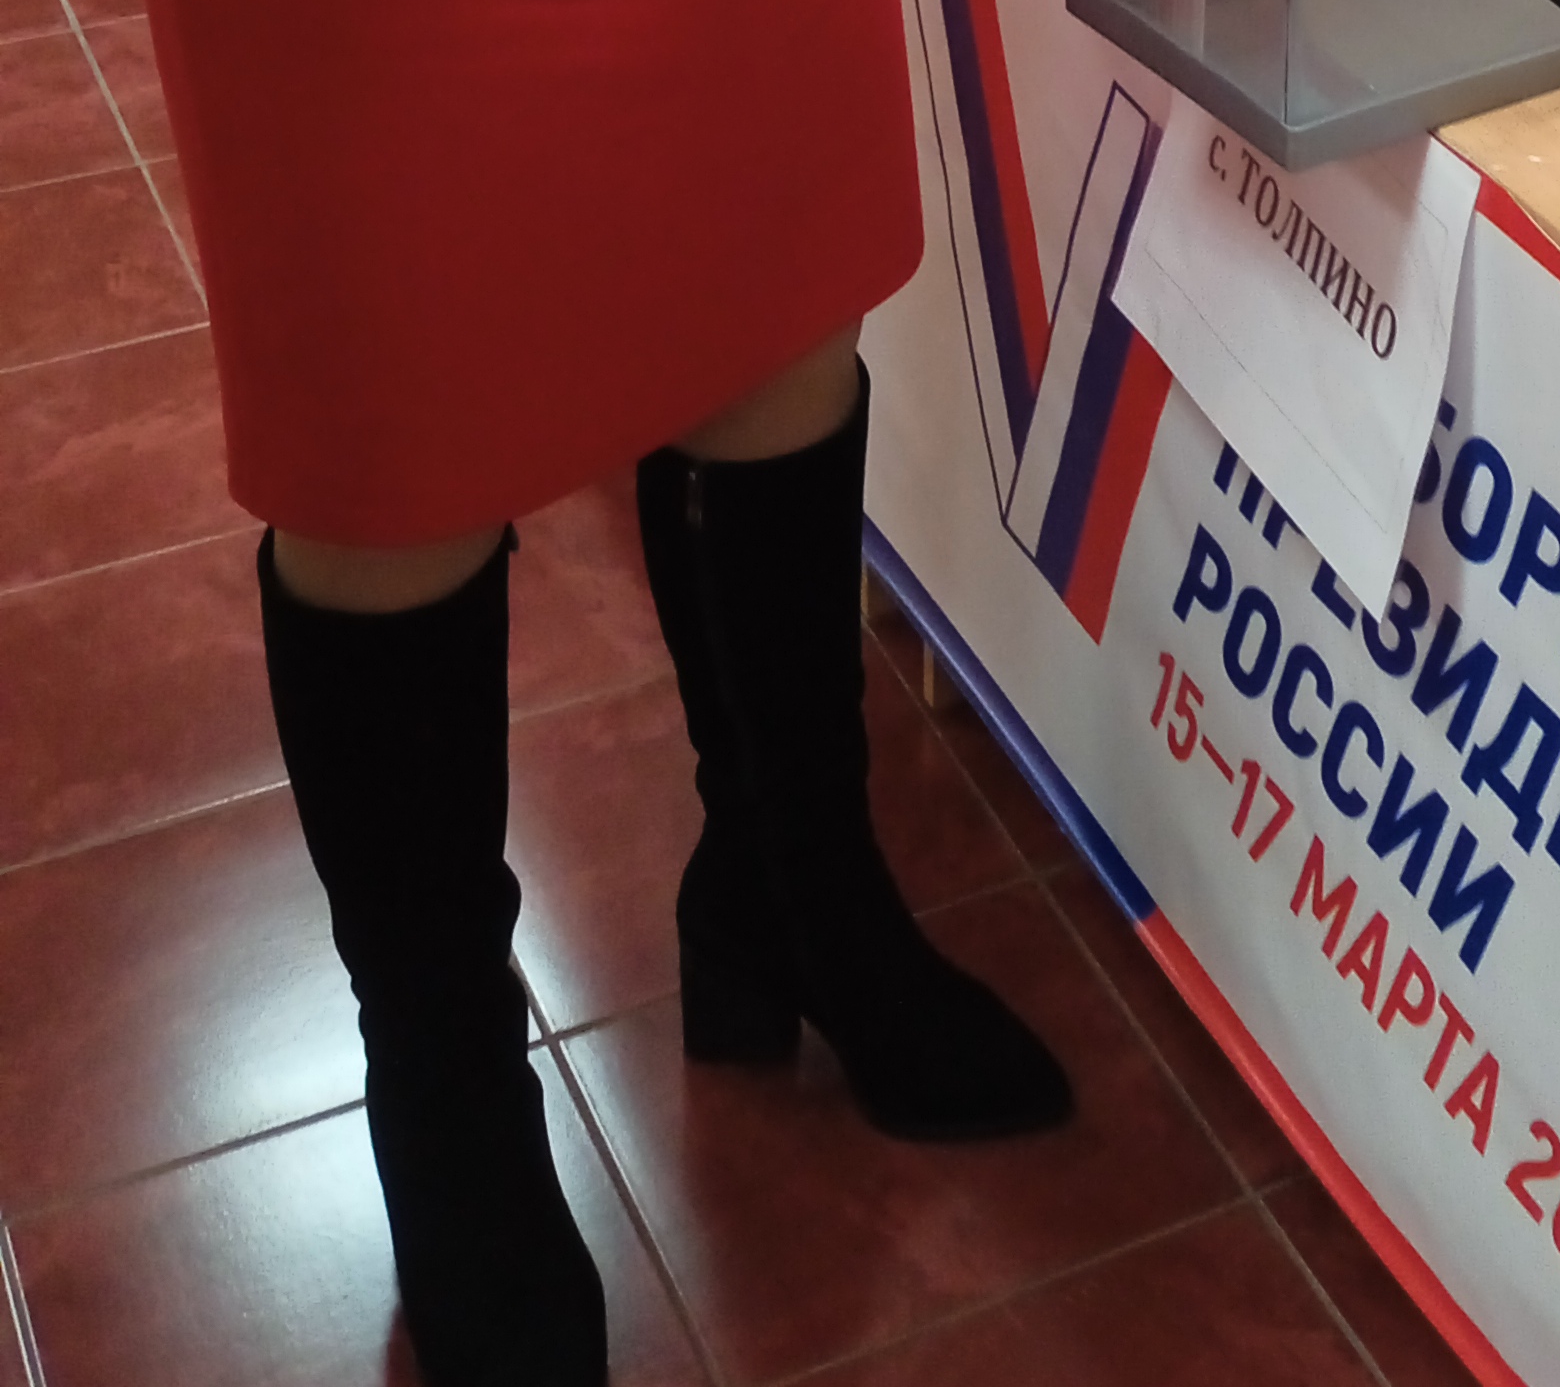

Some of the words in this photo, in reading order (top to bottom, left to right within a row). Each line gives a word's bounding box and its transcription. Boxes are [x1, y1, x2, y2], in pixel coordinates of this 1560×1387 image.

[1237, 147, 1398, 361] ТОЛПИНО
[1172, 523, 1516, 975] РОССИИ
[1290, 833, 1501, 1155] МАРТА
